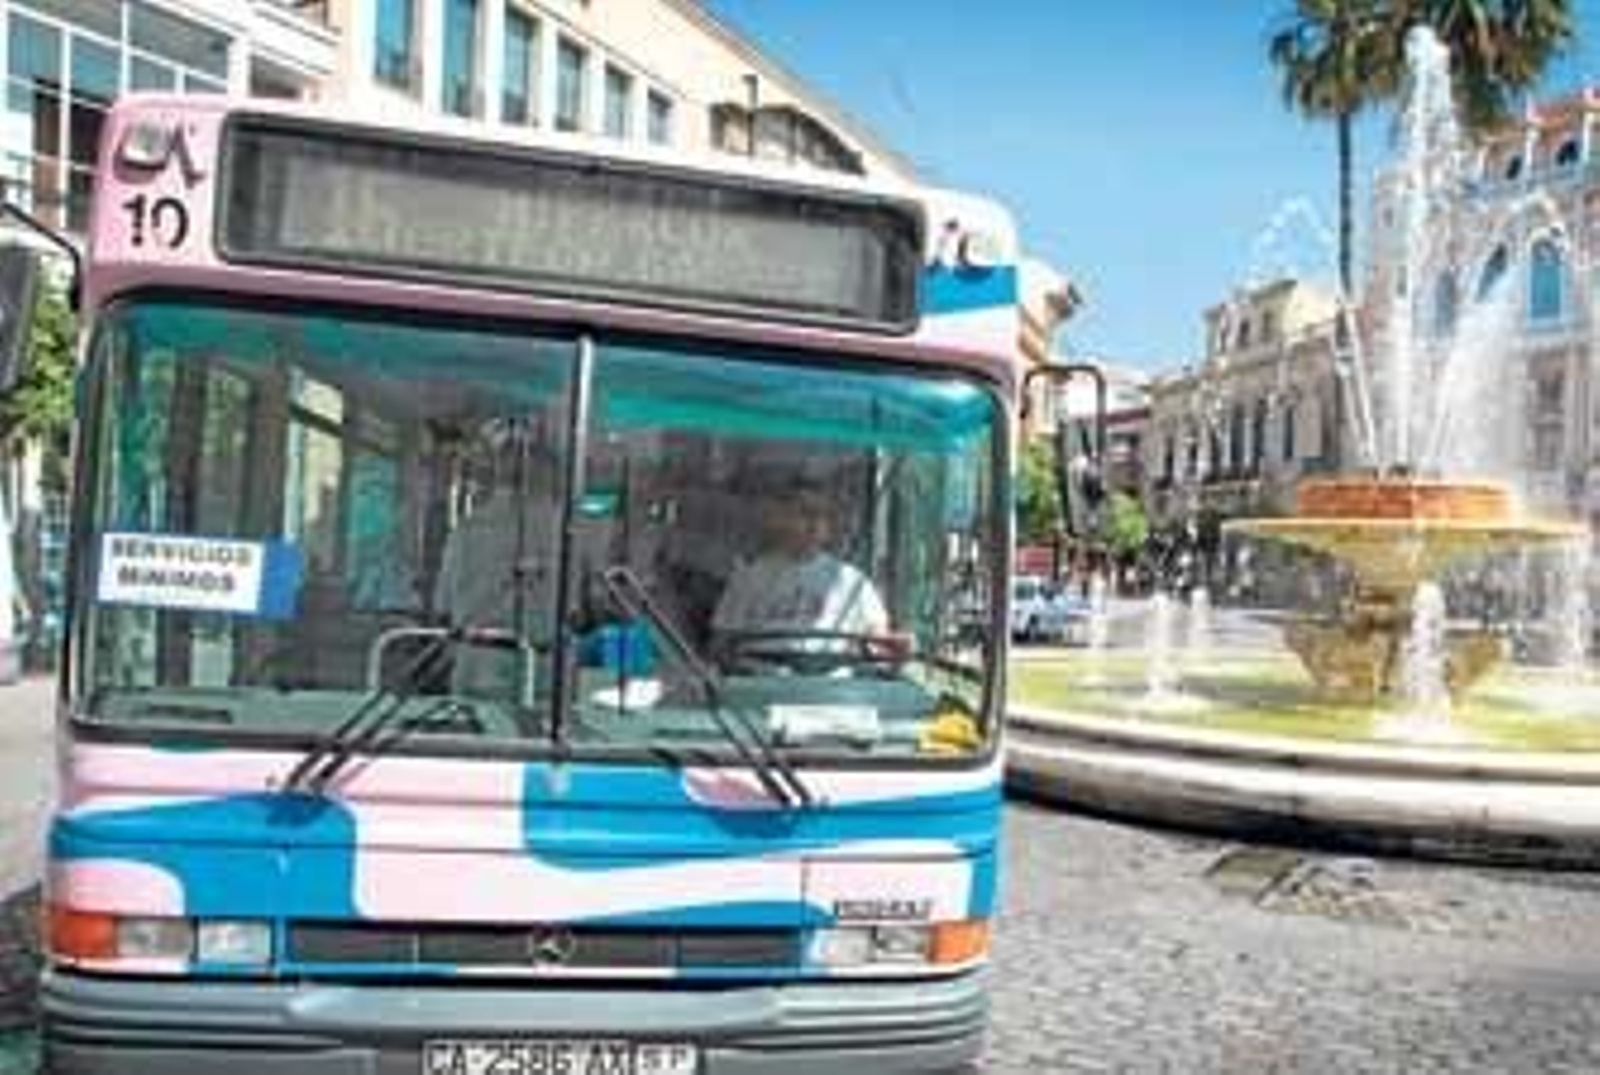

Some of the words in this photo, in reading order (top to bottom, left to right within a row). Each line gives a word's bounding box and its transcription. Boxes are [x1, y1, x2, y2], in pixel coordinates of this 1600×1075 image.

[121, 193, 190, 249] 10
[111, 538, 253, 567] SERVICIOS
[116, 566, 236, 594] MINIMOS
